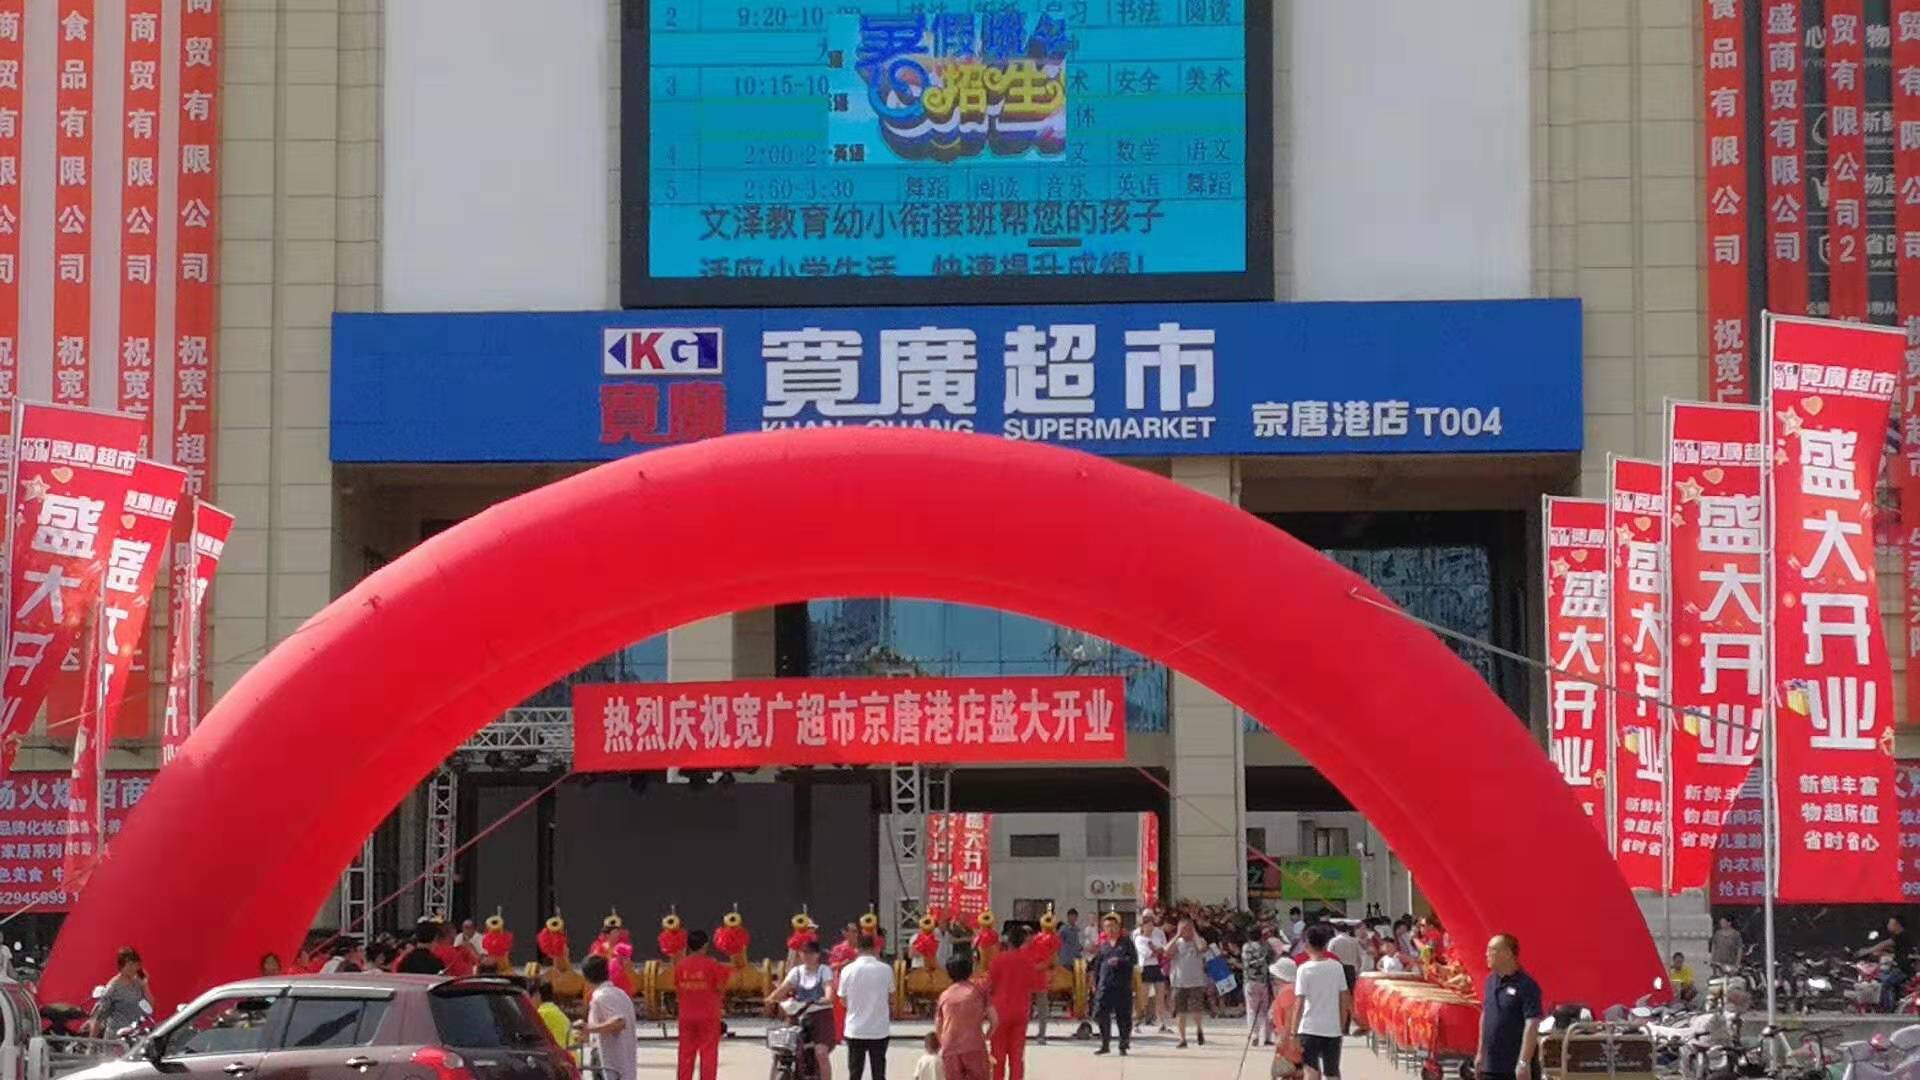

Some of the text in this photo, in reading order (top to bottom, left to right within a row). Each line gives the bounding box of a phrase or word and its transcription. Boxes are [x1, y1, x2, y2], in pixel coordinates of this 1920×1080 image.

[1117, 69, 1161, 95] 安全
[1186, 66, 1232, 92] 美术
[127, 12, 156, 285] 商贸有限公司
[1766, 2, 1801, 263] 盛商贸有限公司
[56, 10, 89, 408] 食品有限公司 祝宽
[699, 200, 1165, 241] 文泽教育幼小衔接班帮您的孩子
[1003, 416, 1215, 442] SUPERMARKET
[1252, 400, 1502, 438] 京唐港店 T004
[1799, 428, 1877, 750] 盛大开业
[1698, 495, 1765, 765] 盛大开业
[1551, 571, 1608, 786] 盛大开业
[602, 688, 1115, 754] 热烈庆祝宽广超市京唐港店盛大开业
[1799, 774, 1880, 797] 新鲜丰富
[1801, 802, 1880, 825] 物超所值
[1803, 830, 1880, 852] 省时省心
